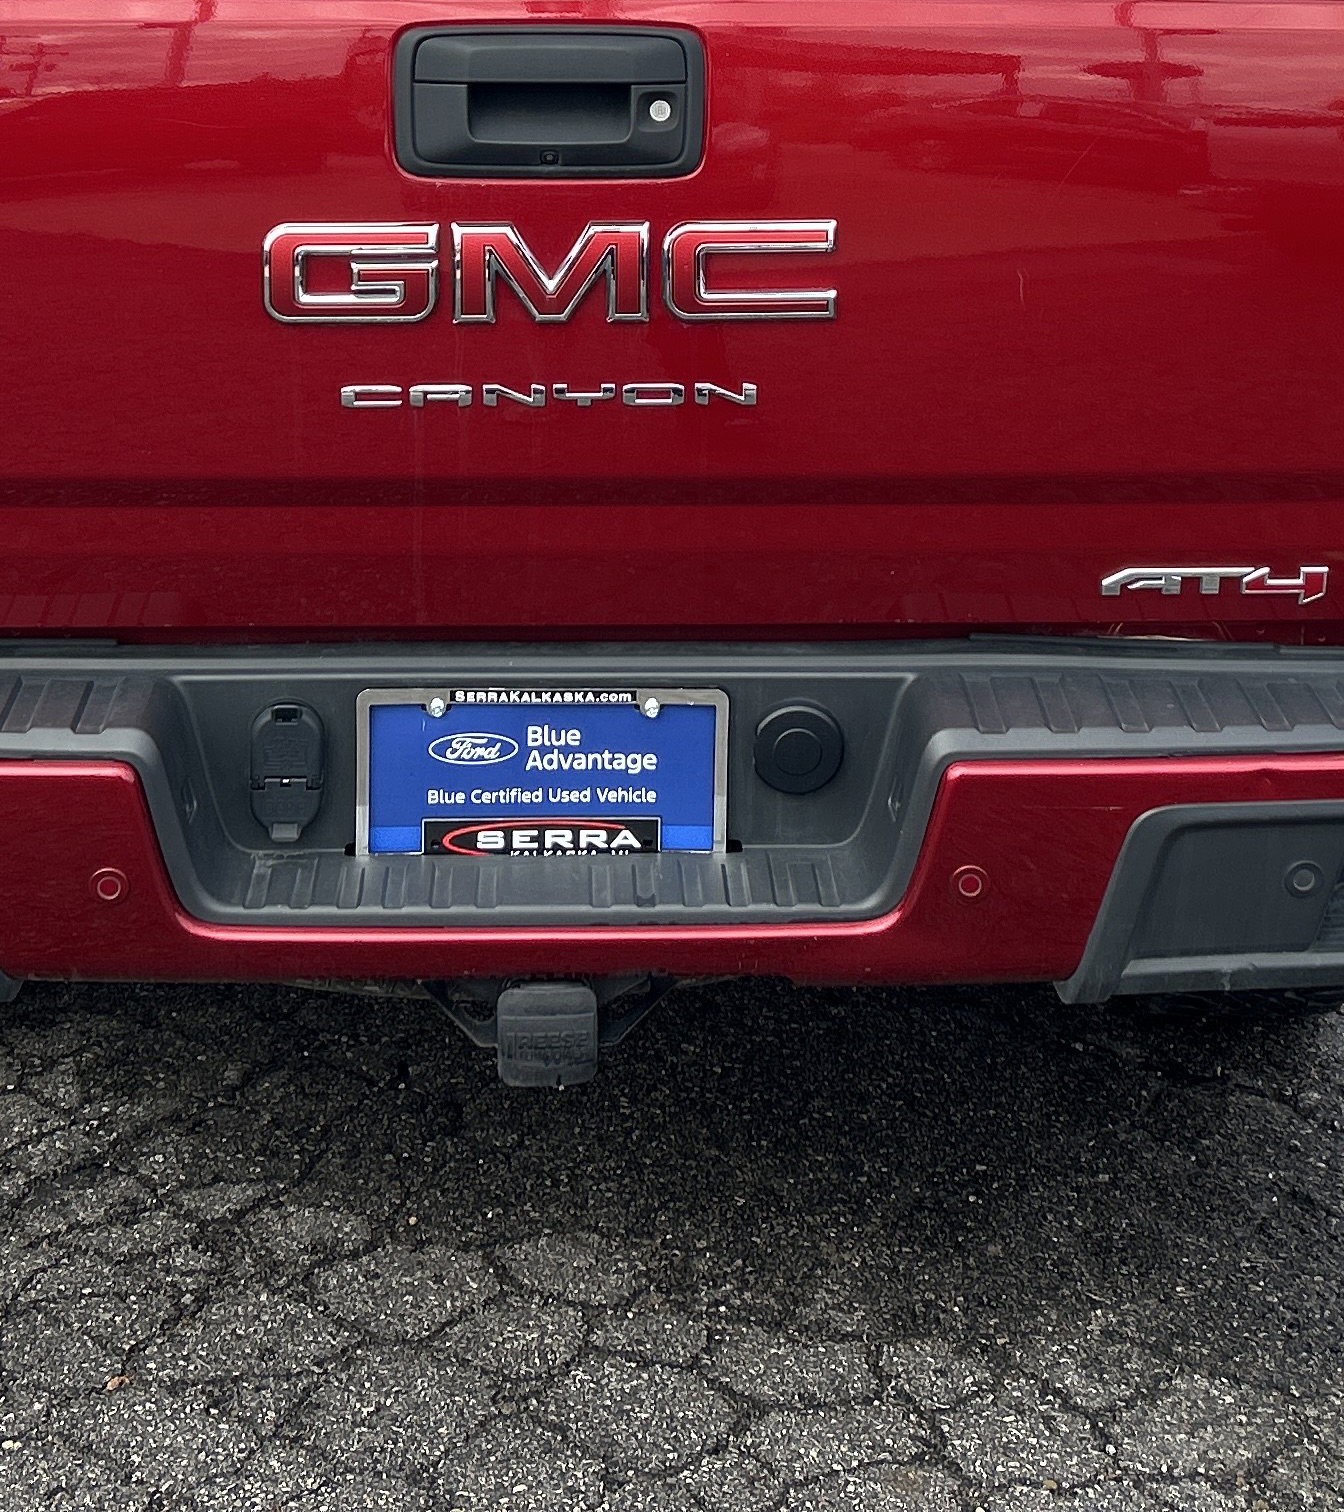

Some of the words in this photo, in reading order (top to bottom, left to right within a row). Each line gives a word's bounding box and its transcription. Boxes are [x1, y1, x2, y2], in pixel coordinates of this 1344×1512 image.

[262, 219, 838, 323] GMC
[341, 382, 758, 408] CANYON
[1101, 566, 1330, 605] AT4
[527, 724, 581, 747] Blue
[445, 737, 502, 760] Ford
[525, 749, 658, 775] Advantage
[427, 789, 465, 804] Blue
[470, 787, 543, 804] Certified
[548, 788, 591, 803] Used
[596, 787, 657, 804] Vehicle
[476, 829, 642, 849] SERRA
